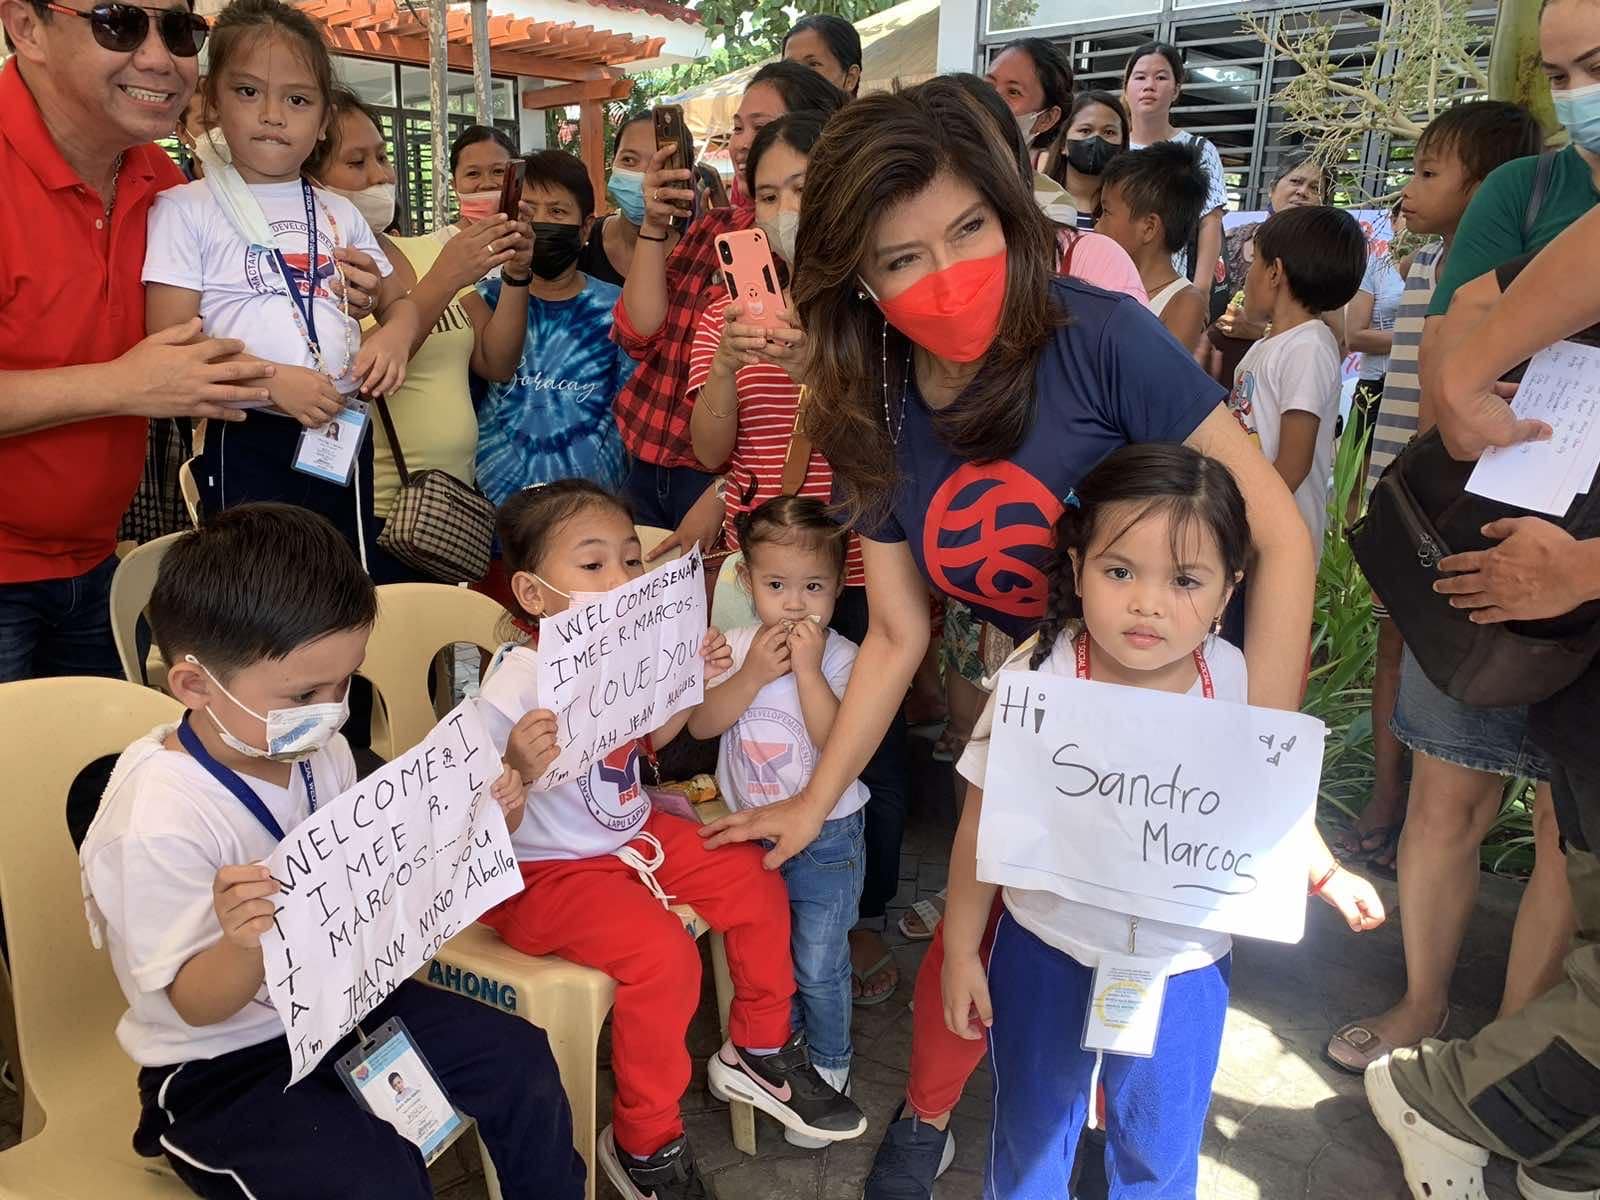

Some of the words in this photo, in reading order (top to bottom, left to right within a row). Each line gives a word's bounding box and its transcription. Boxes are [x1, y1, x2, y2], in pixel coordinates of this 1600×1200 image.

[549, 636, 612, 692] IMEE
[623, 702, 656, 737] JEAN
[1052, 743, 1221, 816] Sandro
[427, 959, 517, 1012] AHONG
